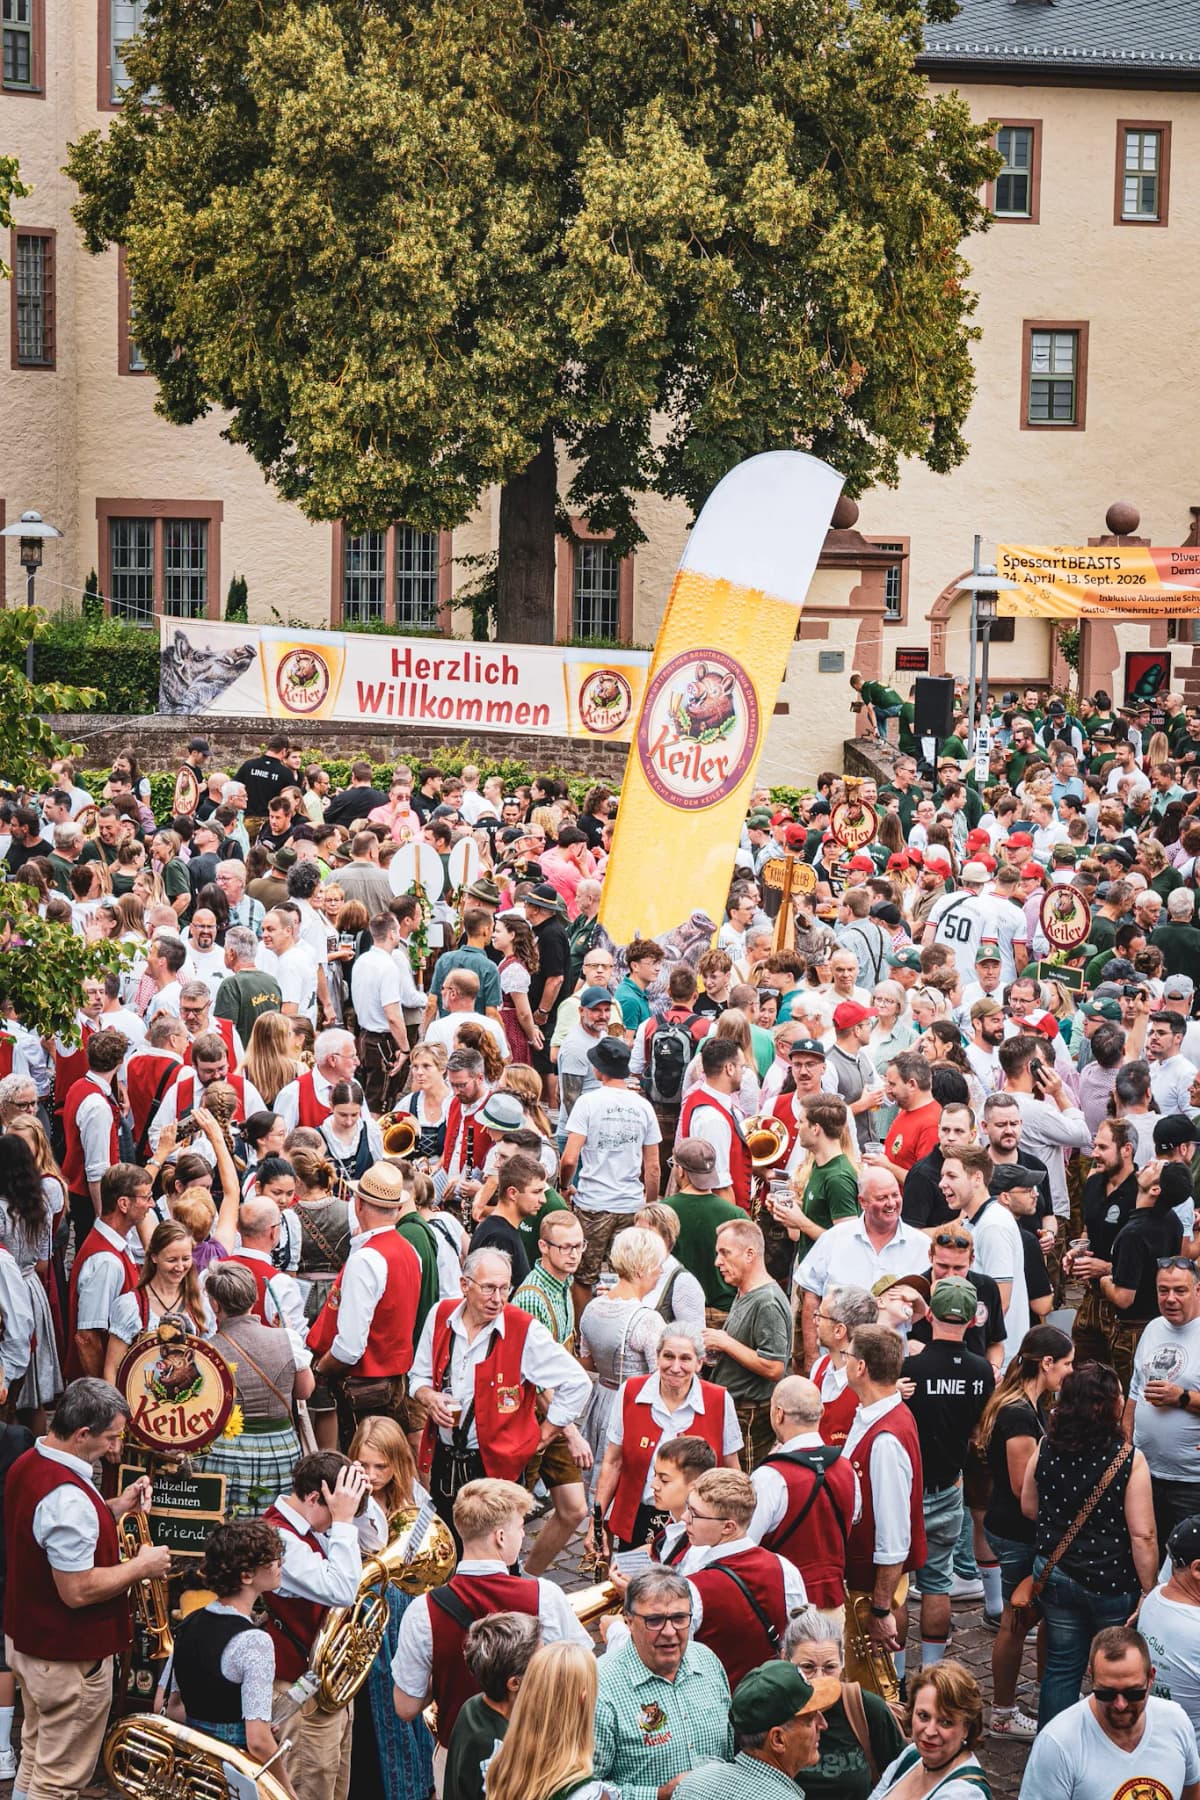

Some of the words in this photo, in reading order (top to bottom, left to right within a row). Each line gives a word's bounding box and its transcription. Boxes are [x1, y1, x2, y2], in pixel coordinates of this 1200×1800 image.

[1003, 554, 1120, 570] SpessartBEASTS
[1024, 573, 1055, 584] April
[1067, 574, 1081, 584] 13.
[1084, 574, 1113, 586] Sept.
[1117, 574, 1147, 585] 2026
[1099, 594, 1137, 602] Inklusive
[1138, 594, 1181, 602] Akademie
[391, 648, 519, 685] Herzlich
[280, 683, 320, 703] Keiler
[356, 680, 550, 726] Willkommen
[582, 704, 622, 724] Keiler
[646, 724, 729, 783] Keiler
[251, 768, 270, 778] LINIE
[271, 773, 279, 781] 11
[836, 823, 870, 842] Keiler
[944, 913, 972, 942] 50
[1047, 916, 1082, 941] Keiler
[926, 1379, 966, 1395] LINIE
[972, 1380, 984, 1395] 11
[129, 1395, 216, 1437] Keiler
[153, 1479, 199, 1493] aldzeller
[153, 1494, 201, 1507] usikanten
